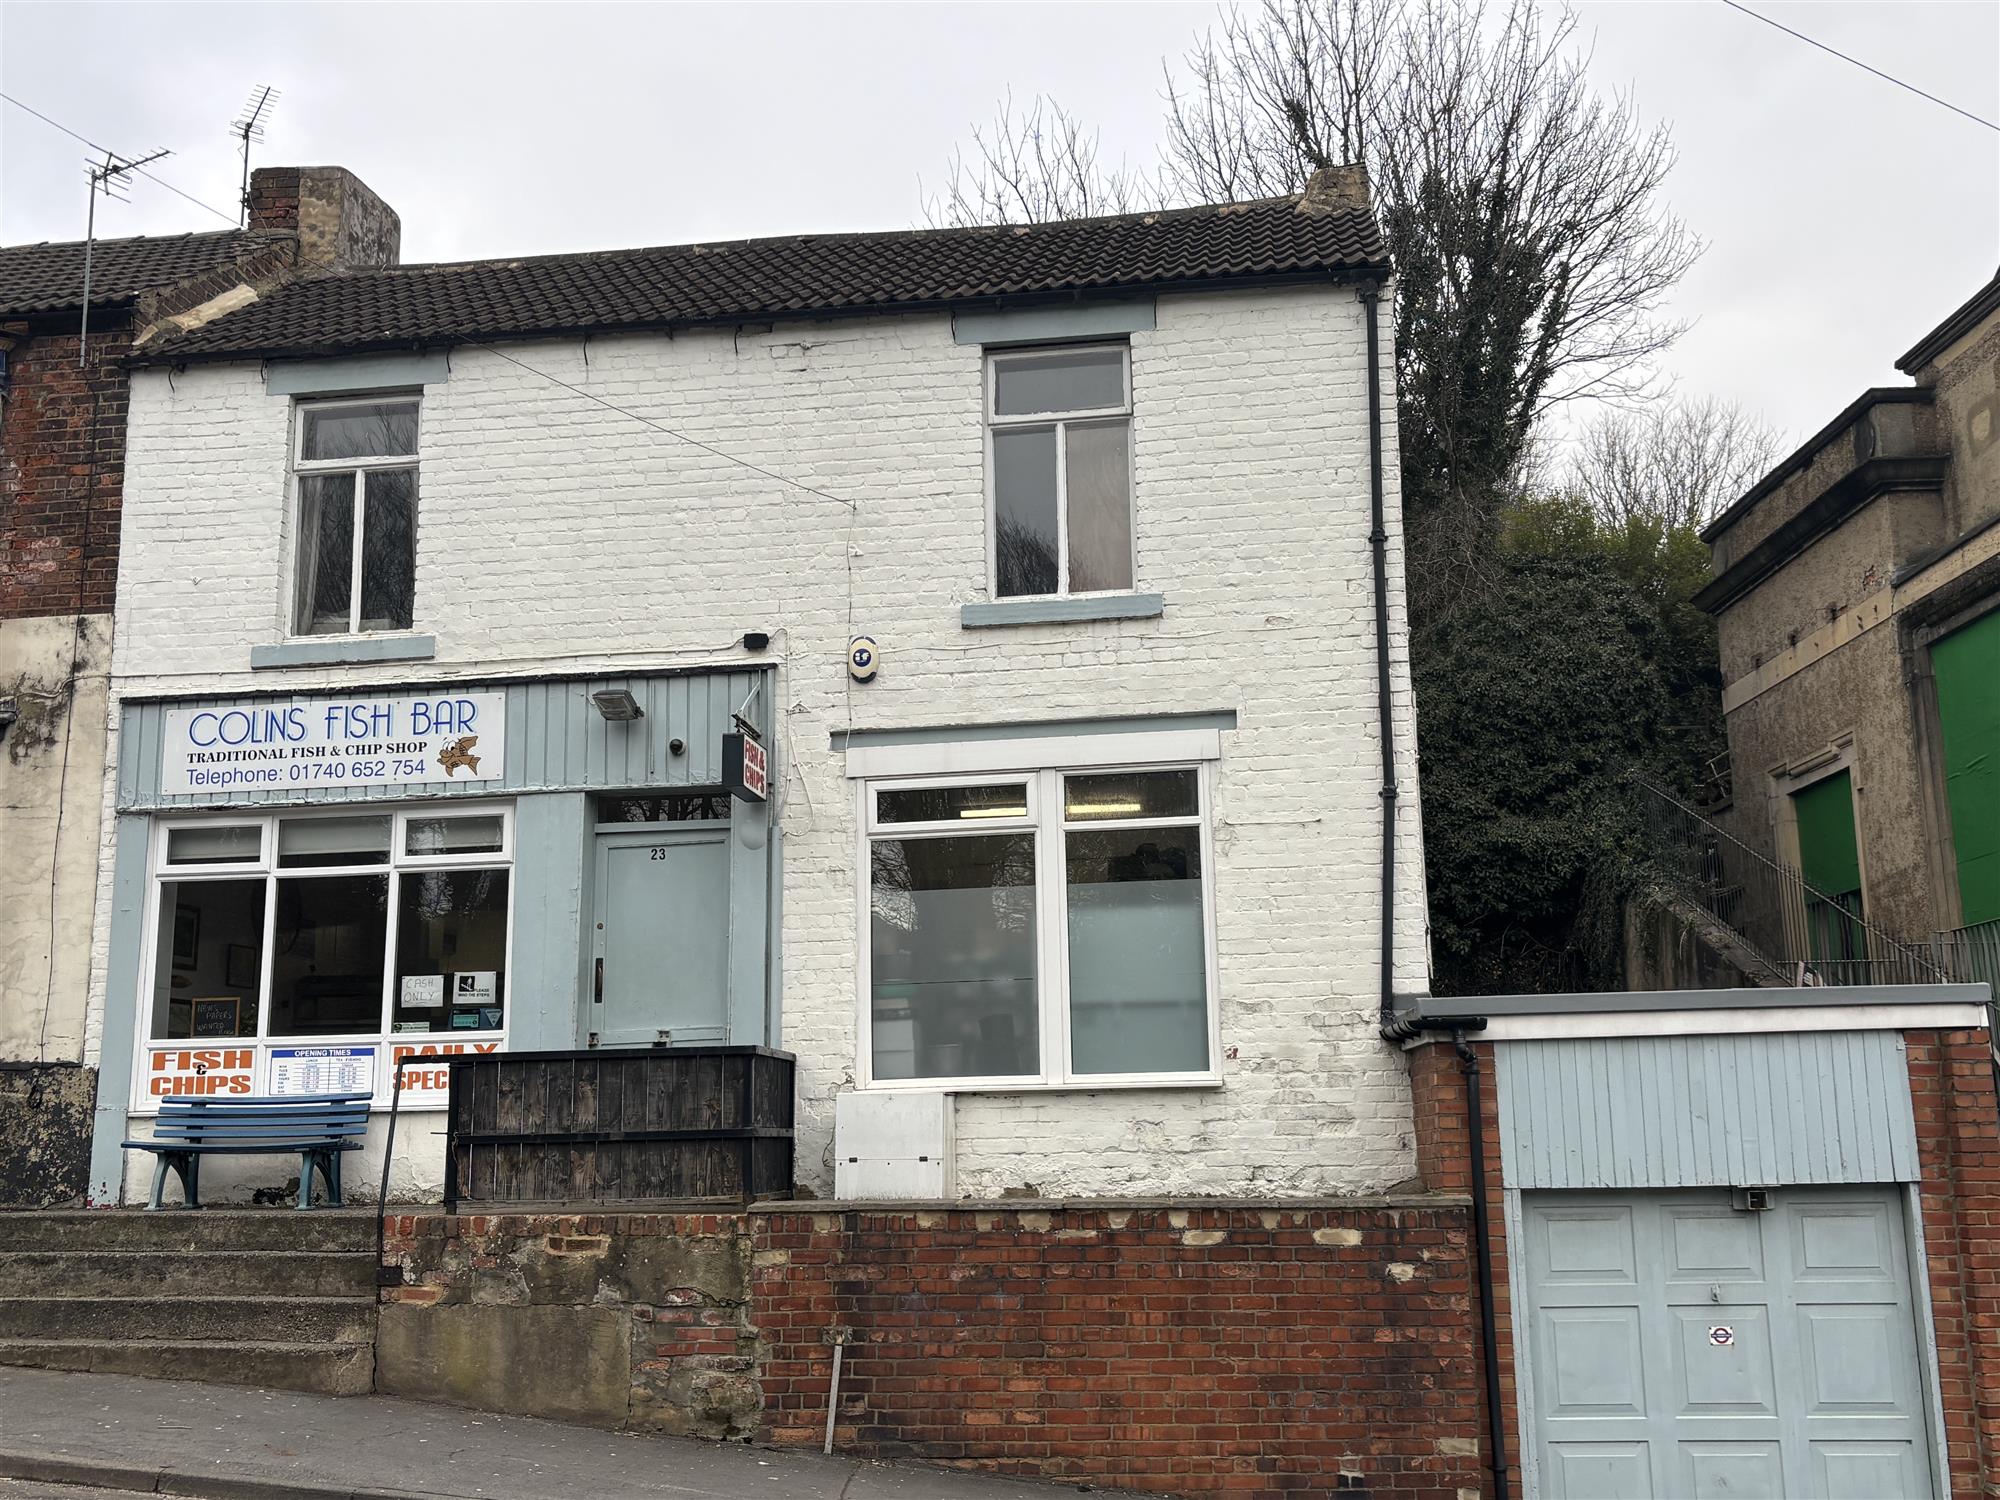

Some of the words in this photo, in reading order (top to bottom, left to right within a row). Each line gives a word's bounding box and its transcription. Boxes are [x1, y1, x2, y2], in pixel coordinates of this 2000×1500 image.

[189, 708, 306, 747] COLINS
[325, 704, 392, 740] FISH
[411, 700, 478, 736] BAR
[187, 748, 288, 764] TRADITIONAL
[291, 746, 326, 760] FISH
[330, 745, 341, 757] &
[345, 743, 382, 756] CHIP
[386, 741, 428, 754] SHOP
[745, 739, 759, 768] FISH
[759, 750, 765, 772] &
[186, 767, 284, 788] Telephone:
[289, 762, 346, 781] 01740
[351, 760, 385, 778] 652
[392, 758, 426, 776] 754
[745, 763, 765, 794] CHIPS
[650, 848, 666, 860] 23
[406, 978, 434, 988] CASH
[404, 991, 435, 1002] ONLY
[152, 1050, 253, 1071] FISH
[294, 1049, 328, 1057] OPENING
[196, 1063, 207, 1075] &
[150, 1075, 251, 1095] CHIPS
[393, 1070, 450, 1090] SPEC
